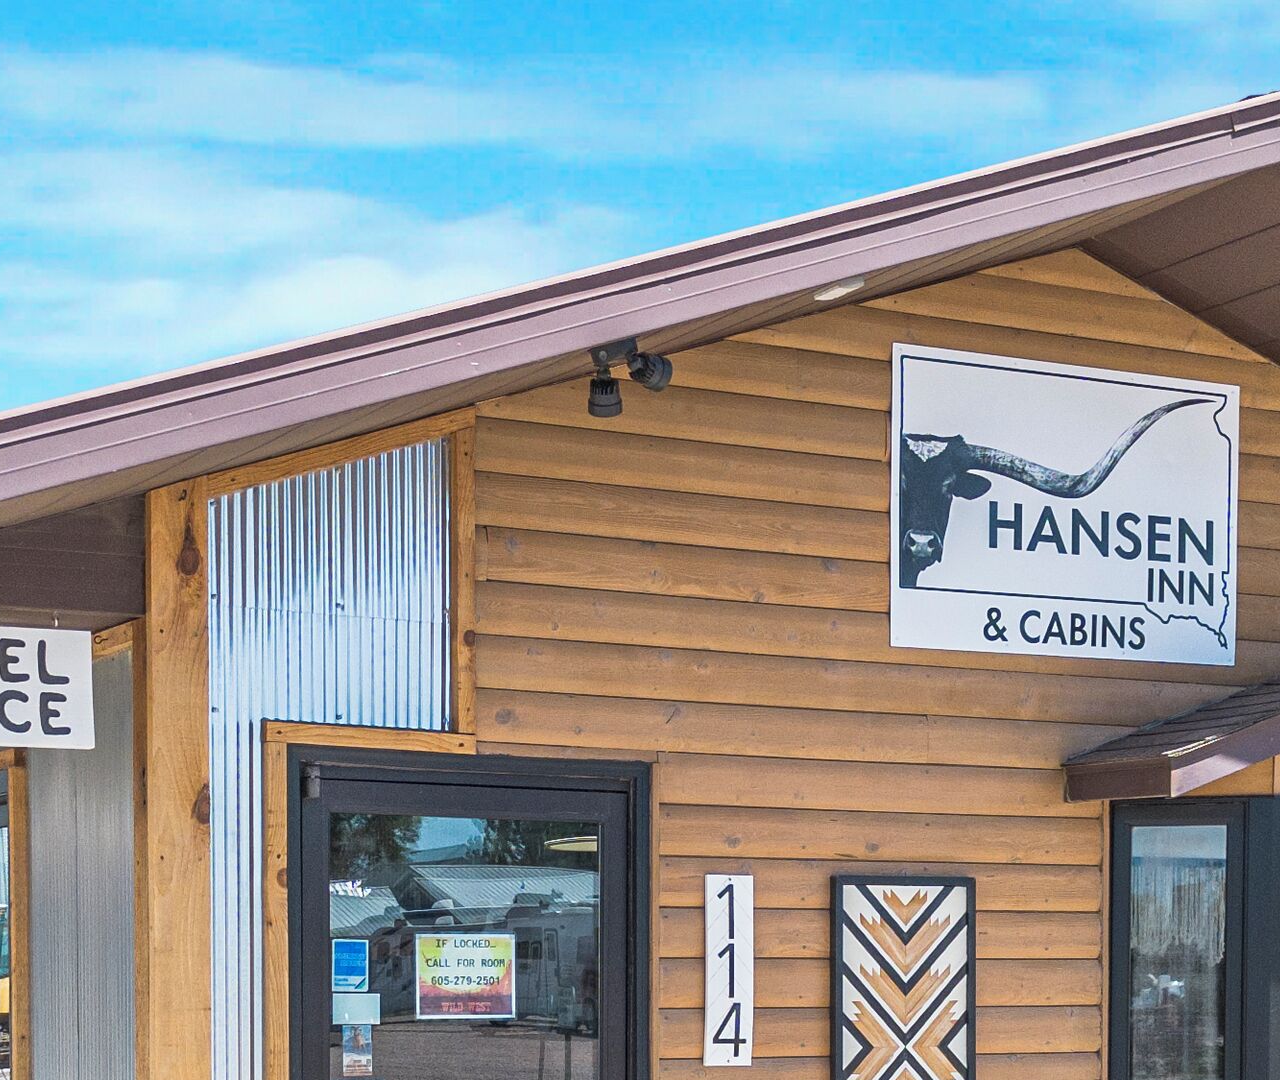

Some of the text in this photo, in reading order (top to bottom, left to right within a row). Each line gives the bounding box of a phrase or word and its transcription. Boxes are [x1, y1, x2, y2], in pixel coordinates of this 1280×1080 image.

[987, 501, 1214, 566] HANSEN
[1147, 568, 1214, 606] INN
[983, 607, 1146, 650] & CABINS
[435, 939, 447, 948] IF
[426, 959, 506, 967] CALL FOR ROOM
[431, 976, 500, 985] 605-279-2501
[713, 883, 747, 1058] 114
